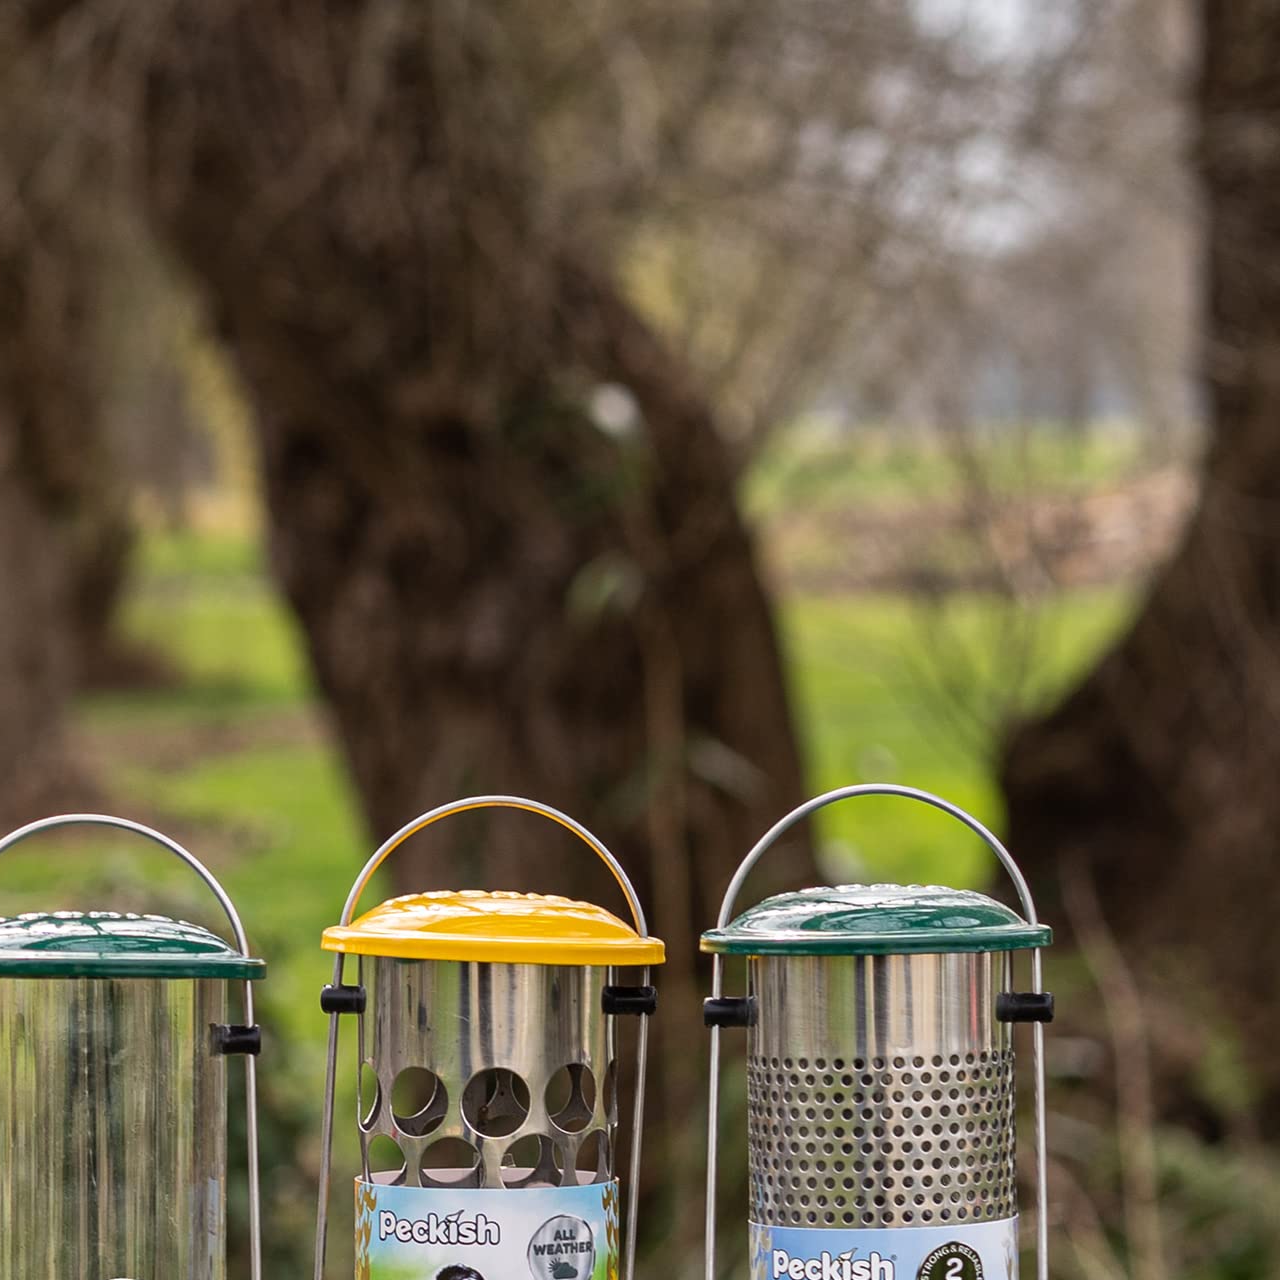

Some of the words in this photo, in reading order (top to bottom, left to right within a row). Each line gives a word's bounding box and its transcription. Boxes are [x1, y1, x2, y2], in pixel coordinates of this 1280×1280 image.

[379, 1209, 500, 1245] Peckish
[553, 1229, 576, 1241] ALL
[533, 1241, 592, 1256] WEATHER
[945, 1257, 963, 1280] 2
